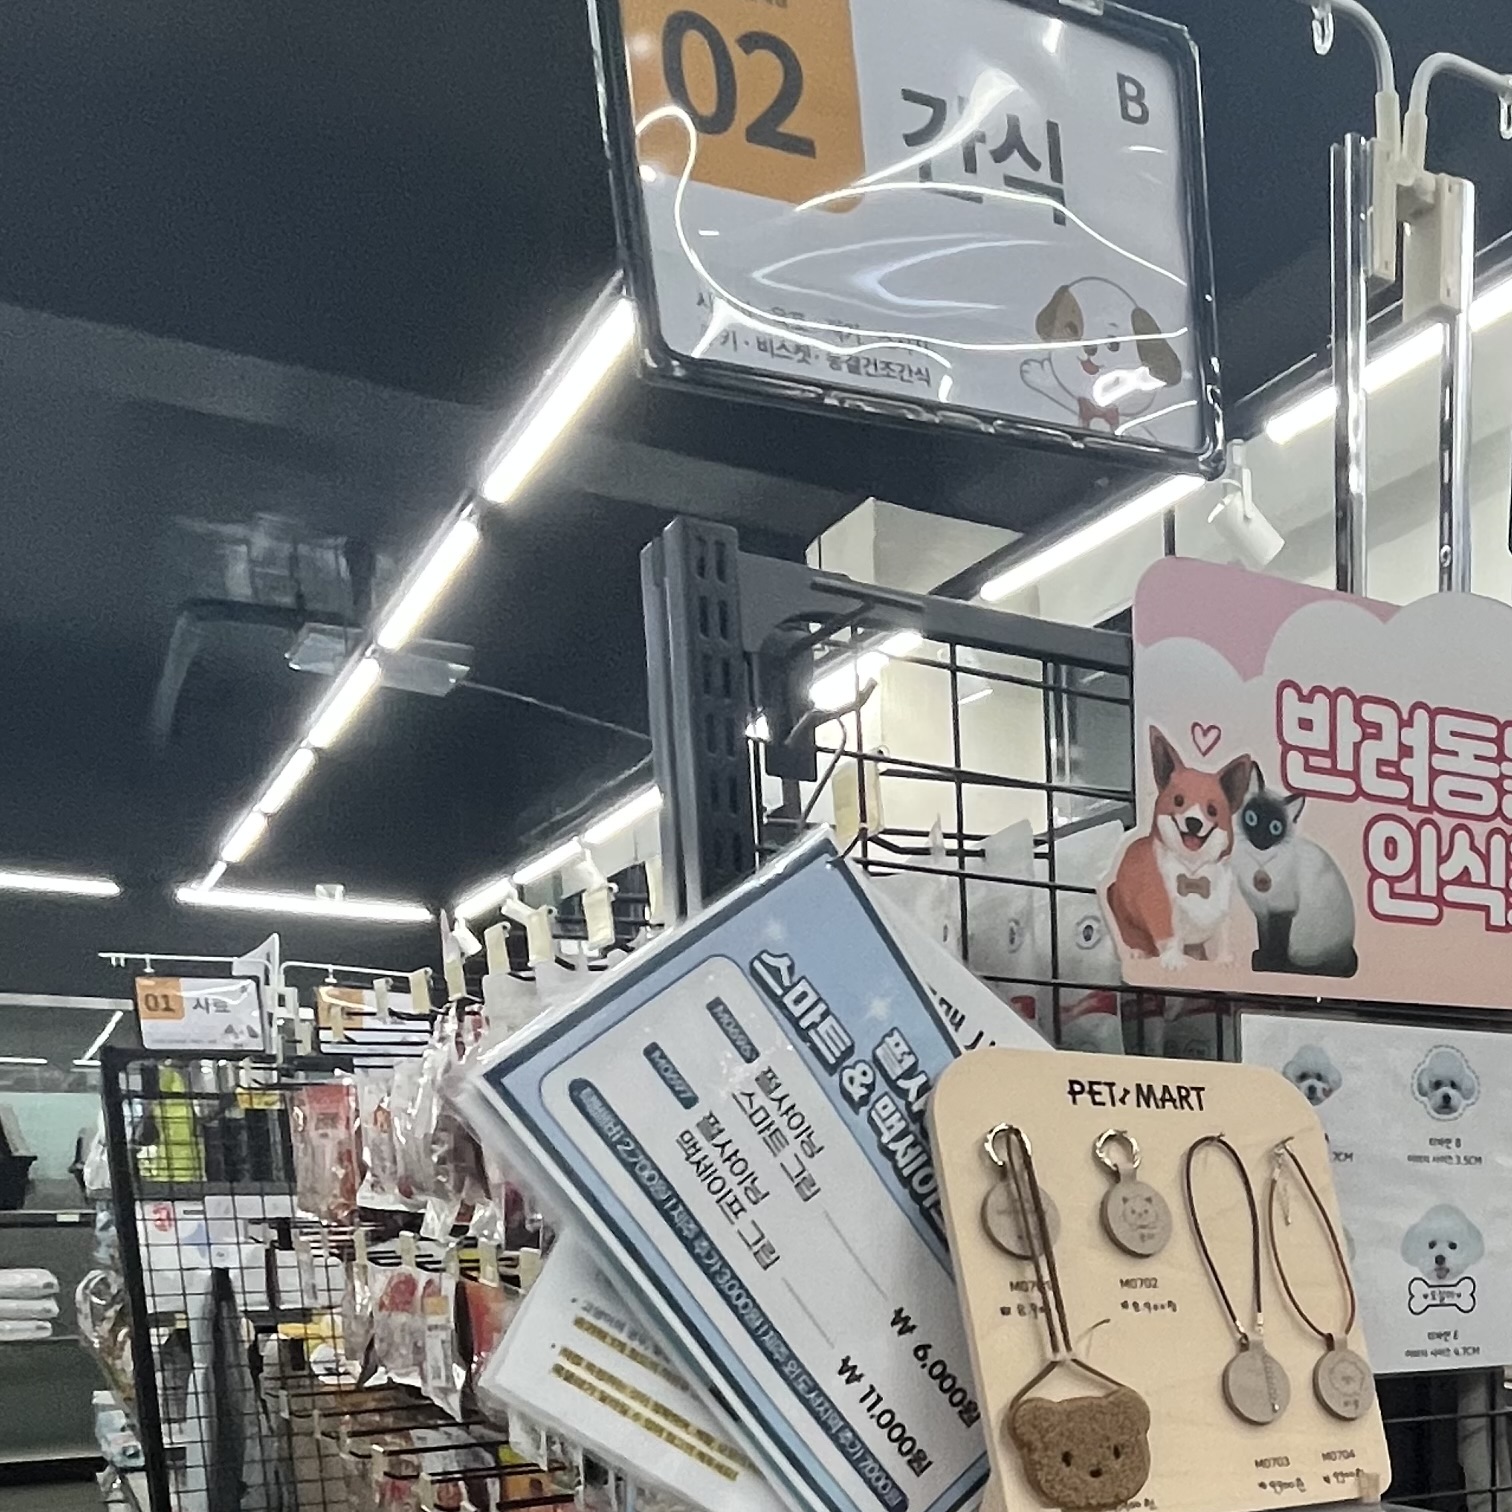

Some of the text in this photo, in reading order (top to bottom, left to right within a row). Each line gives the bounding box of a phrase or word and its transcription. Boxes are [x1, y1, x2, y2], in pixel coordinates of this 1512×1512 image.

[661, 10, 816, 160] 02
[1116, 72, 1150, 125] B
[901, 88, 1067, 227] 간식
[144, 993, 176, 1014] 01
[748, 948, 859, 1086] 스마트
[731, 1091, 821, 1202] 스마트 그립
[1067, 1079, 1206, 1112] PET MART
[676, 1130, 780, 1271] 맥세이프 그립
